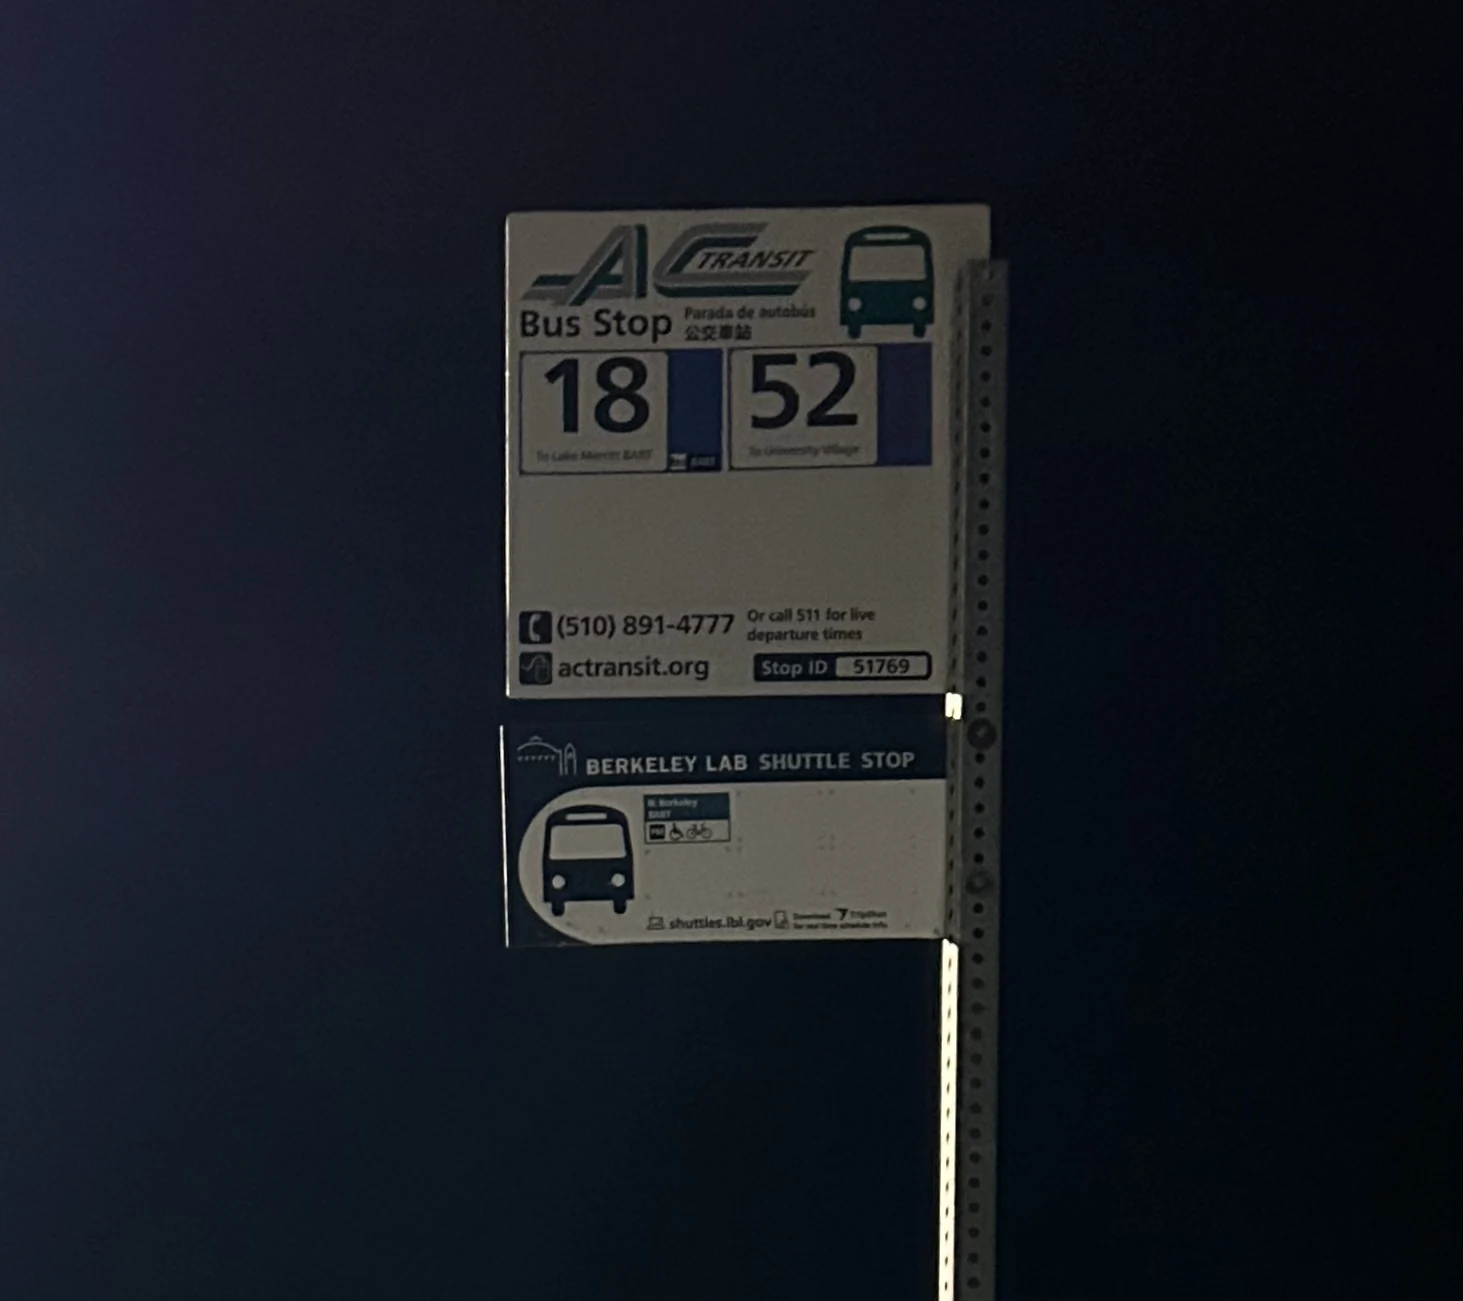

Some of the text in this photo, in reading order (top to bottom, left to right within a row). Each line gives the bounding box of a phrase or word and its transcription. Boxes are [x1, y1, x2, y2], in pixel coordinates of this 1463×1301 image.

[697, 250, 816, 270] TRANSIT
[685, 303, 816, 320] Parada de autobús
[521, 308, 673, 343] Bus Stop
[544, 357, 650, 434] 18
[751, 351, 858, 430] 52
[747, 607, 876, 622] Or call 511 for live
[557, 613, 735, 640] (510) 891-4777
[747, 627, 863, 643] departure times
[558, 656, 710, 682] actransit.org
[761, 659, 828, 678] Stop ID
[853, 658, 910, 675] 51769
[586, 751, 916, 776] BERKELEY LAB SHUTTLE STOP
[669, 915, 773, 931] shuttles.lbl.gov
